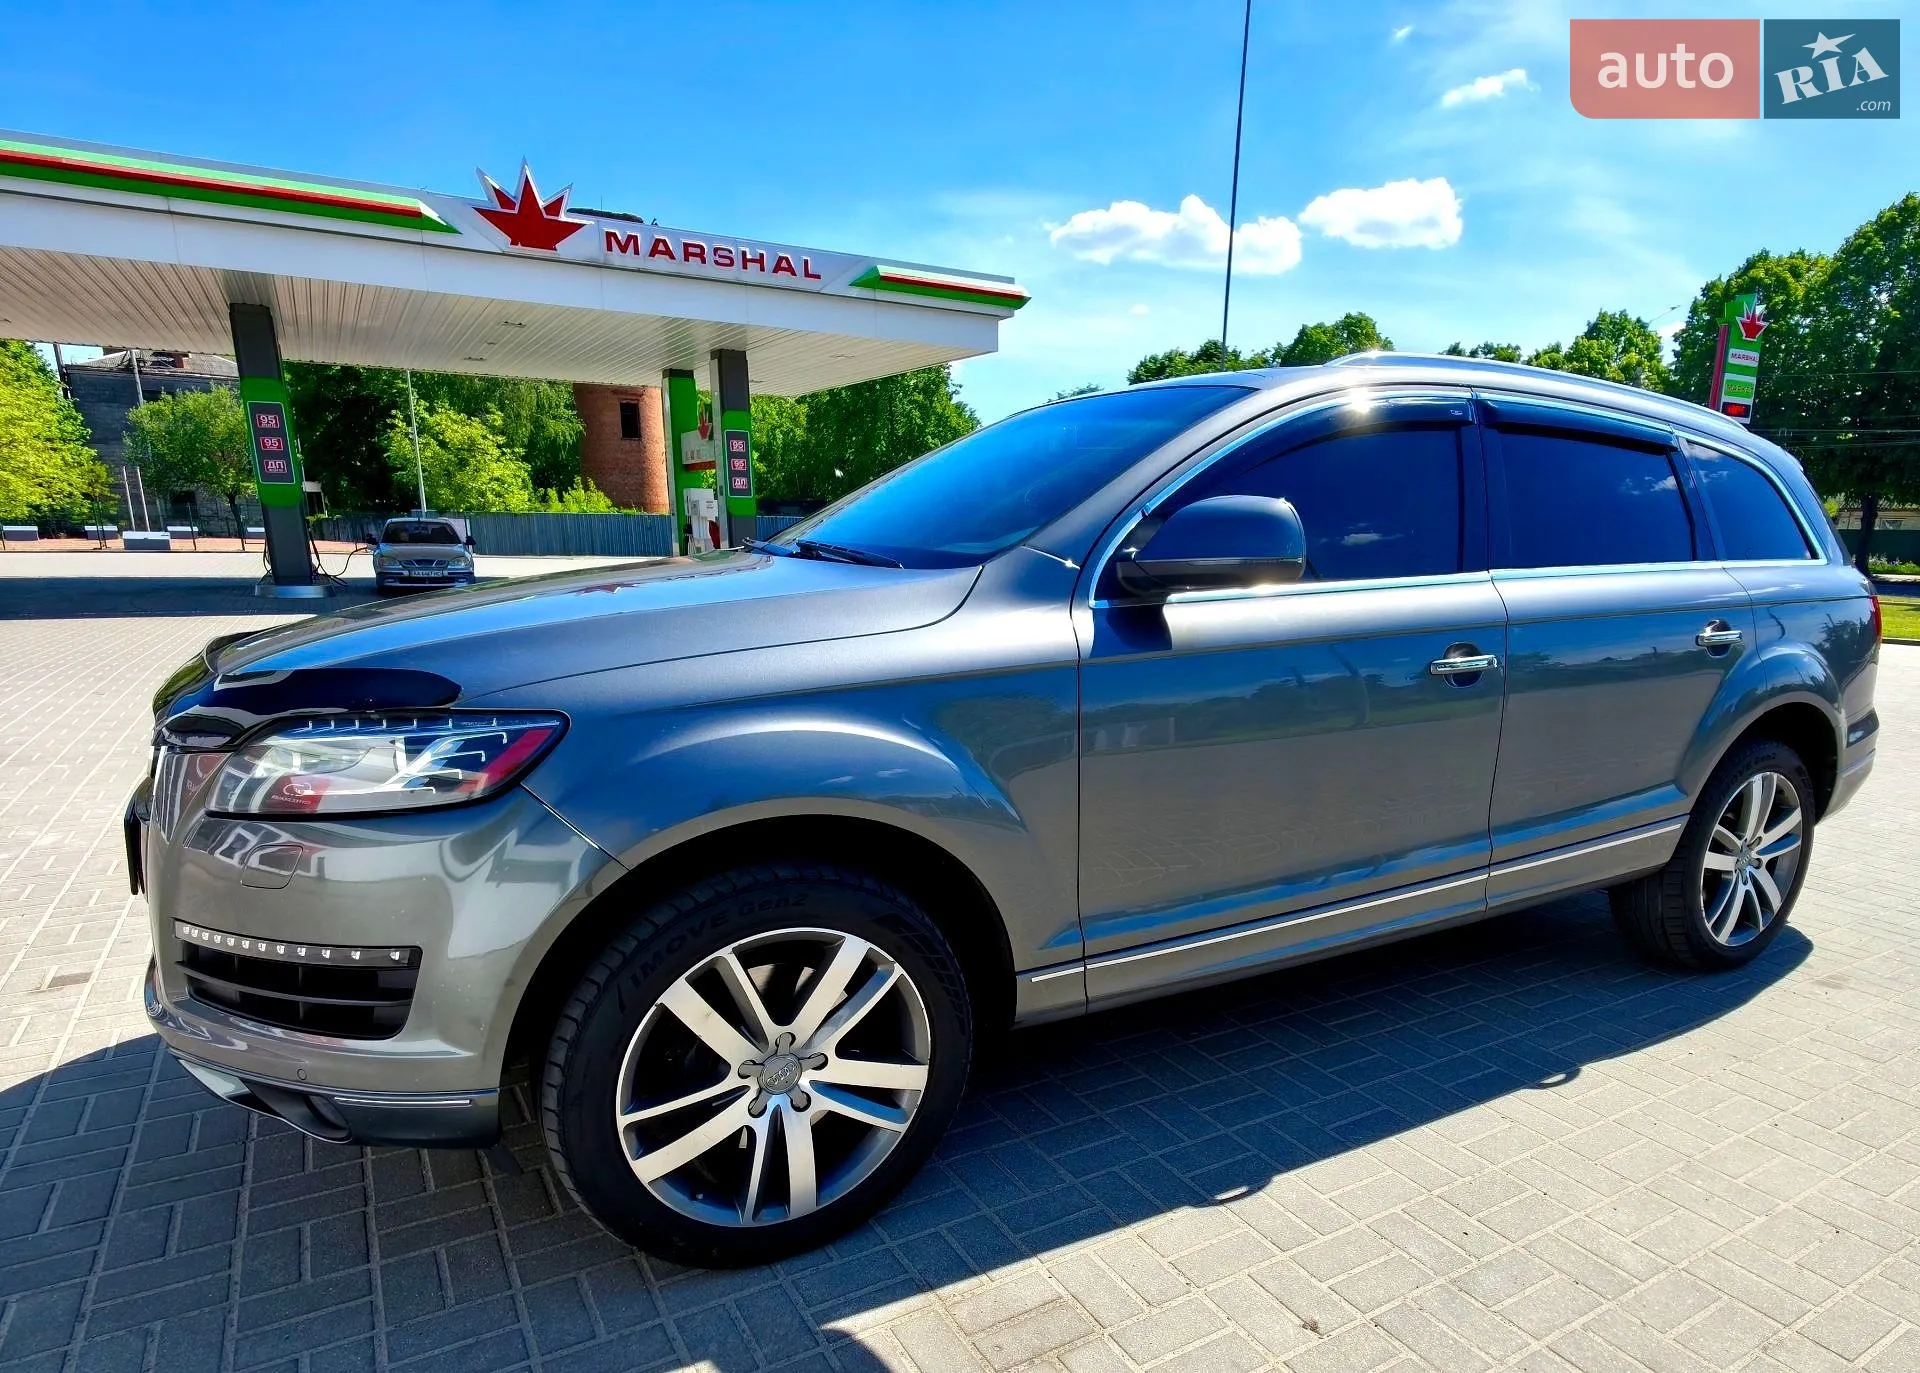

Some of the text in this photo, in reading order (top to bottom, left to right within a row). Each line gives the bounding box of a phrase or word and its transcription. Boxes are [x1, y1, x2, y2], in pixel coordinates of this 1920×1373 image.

[604, 229, 822, 280] MARSHAL
[260, 415, 275, 424] 95
[264, 438, 279, 447] 95
[732, 441, 744, 449] 95
[267, 461, 284, 469] ДП
